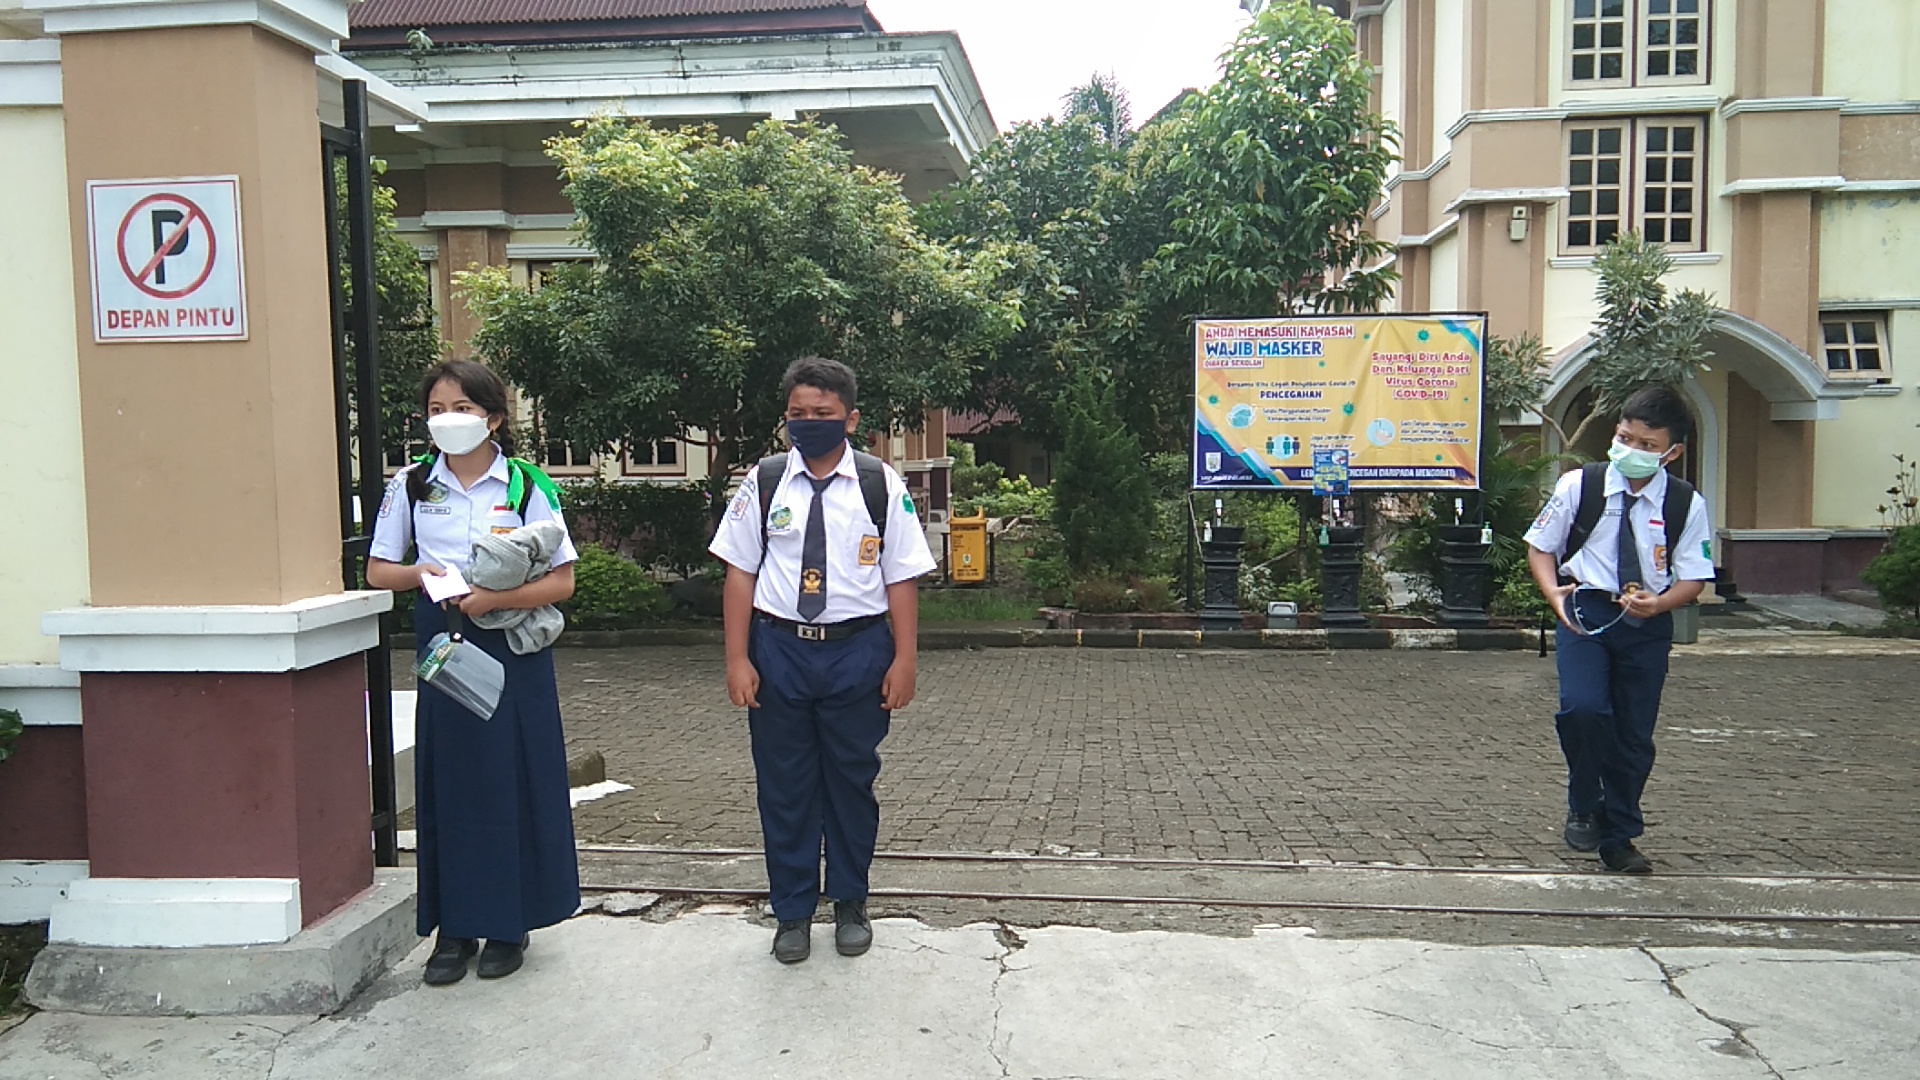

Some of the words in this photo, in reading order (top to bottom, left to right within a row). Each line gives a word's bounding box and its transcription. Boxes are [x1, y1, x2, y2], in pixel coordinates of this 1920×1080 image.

[152, 209, 189, 284] P
[107, 308, 169, 329] DEPAN
[176, 307, 234, 327] PINTU
[1205, 327, 1235, 338] ANDA
[1238, 326, 1297, 337] MEMASUKI
[1300, 325, 1353, 337] KAWASAN
[1205, 341, 1253, 356] WAJIB
[1258, 340, 1322, 356] MASKER
[1231, 359, 1262, 367] SEKOLAH
[1372, 352, 1415, 364] Sayangi
[1419, 352, 1439, 361] Diri
[1442, 352, 1471, 361] Anda
[1372, 365, 1393, 373] Dan
[1396, 365, 1443, 376] Keluarga
[1446, 365, 1469, 373] Dari
[1386, 377, 1413, 386] Virus
[1416, 377, 1455, 386] Corona
[1259, 390, 1322, 398] PENCEGAHAN
[1392, 390, 1448, 399] (COVID-19)
[1348, 468, 1378, 477] NCEGAH
[1379, 468, 1414, 477] DARIPADA
[1415, 468, 1456, 478] MENGOBATI
